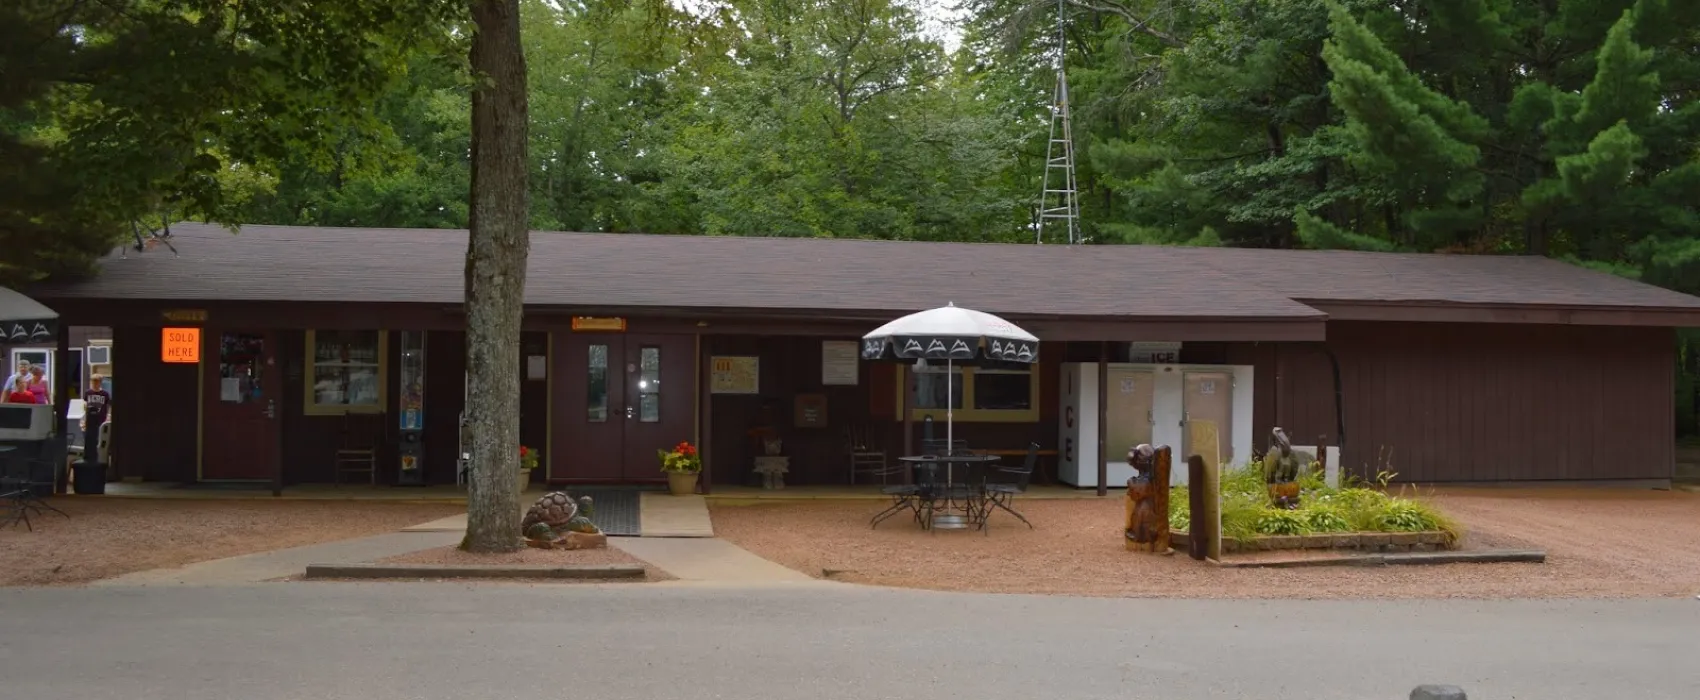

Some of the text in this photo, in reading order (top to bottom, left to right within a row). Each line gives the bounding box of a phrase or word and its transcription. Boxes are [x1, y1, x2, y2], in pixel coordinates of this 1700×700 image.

[169, 333, 194, 342] SOLD
[168, 348, 193, 357] HERE
[1151, 353, 1175, 363] ICE
[1066, 371, 1074, 462] ICE
